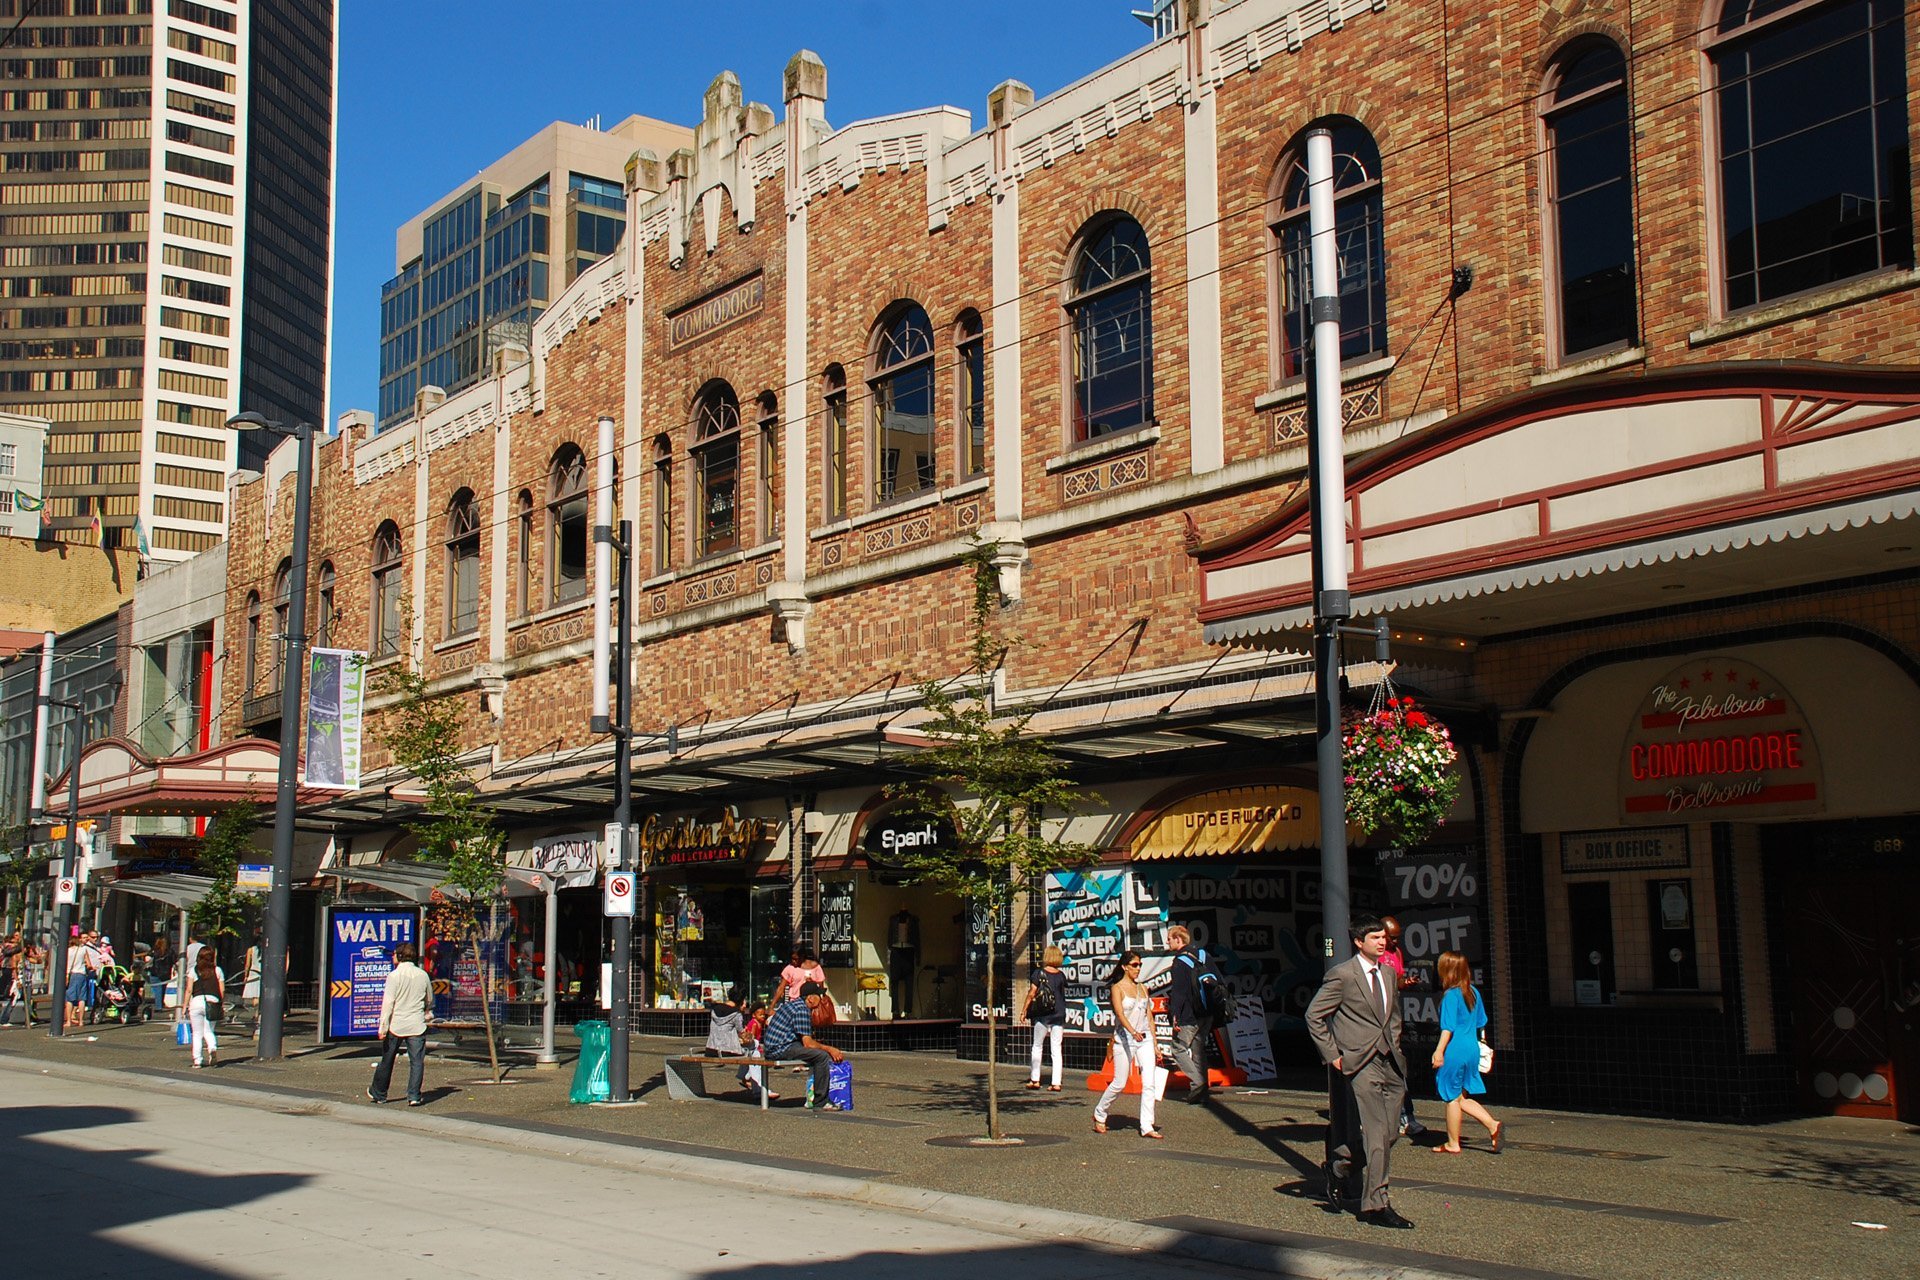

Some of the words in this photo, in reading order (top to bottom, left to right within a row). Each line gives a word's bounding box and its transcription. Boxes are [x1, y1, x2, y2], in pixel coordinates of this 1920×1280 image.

[676, 283, 758, 341] COMMODORE
[342, 653, 361, 786] RANVILLE
[1652, 685, 1677, 707] The
[1671, 693, 1768, 733] Fabulous
[1631, 730, 1803, 780] COMMODORE
[1666, 778, 1762, 814] Ballroom
[1186, 806, 1301, 827] UNDERWORLD
[640, 814, 713, 866] Golden
[716, 804, 762, 861] Age
[882, 824, 937, 854] Spank
[1874, 837, 1902, 853] 868
[1378, 851, 1391, 860] UP
[1392, 850, 1403, 859] TO
[1586, 842, 1611, 859] BOX
[1616, 839, 1662, 858] OFFICE
[1395, 863, 1477, 899] 70%
[822, 896, 852, 911] SUMMER
[1053, 899, 1120, 925] LIQUIDATION
[336, 919, 410, 943] WAIT!
[822, 914, 852, 942] SALE
[1234, 931, 1269, 947] FOR
[1404, 916, 1471, 957] OFF
[1058, 935, 1116, 955] CENTER
[1064, 988, 1090, 997] ECIALS
[972, 1004, 1007, 1020] Spnk
